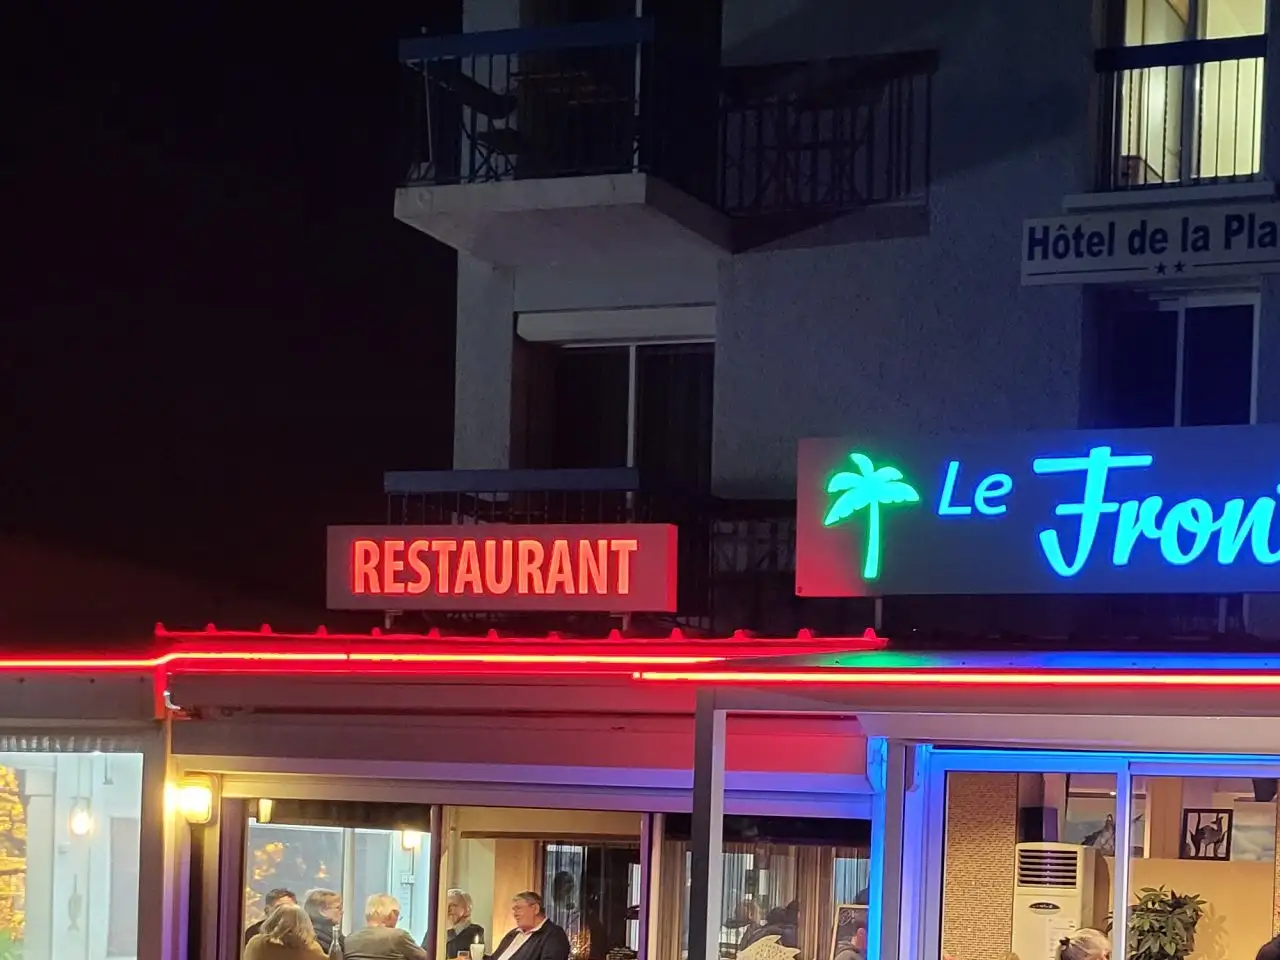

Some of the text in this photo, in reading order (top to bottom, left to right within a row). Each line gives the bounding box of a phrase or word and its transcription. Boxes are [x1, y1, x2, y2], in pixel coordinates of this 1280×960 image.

[1027, 221, 1116, 261] Hôtel
[1127, 219, 1169, 256] de
[1180, 217, 1211, 253] la
[937, 459, 1013, 516] Le
[352, 538, 638, 595] RESTAURANT
